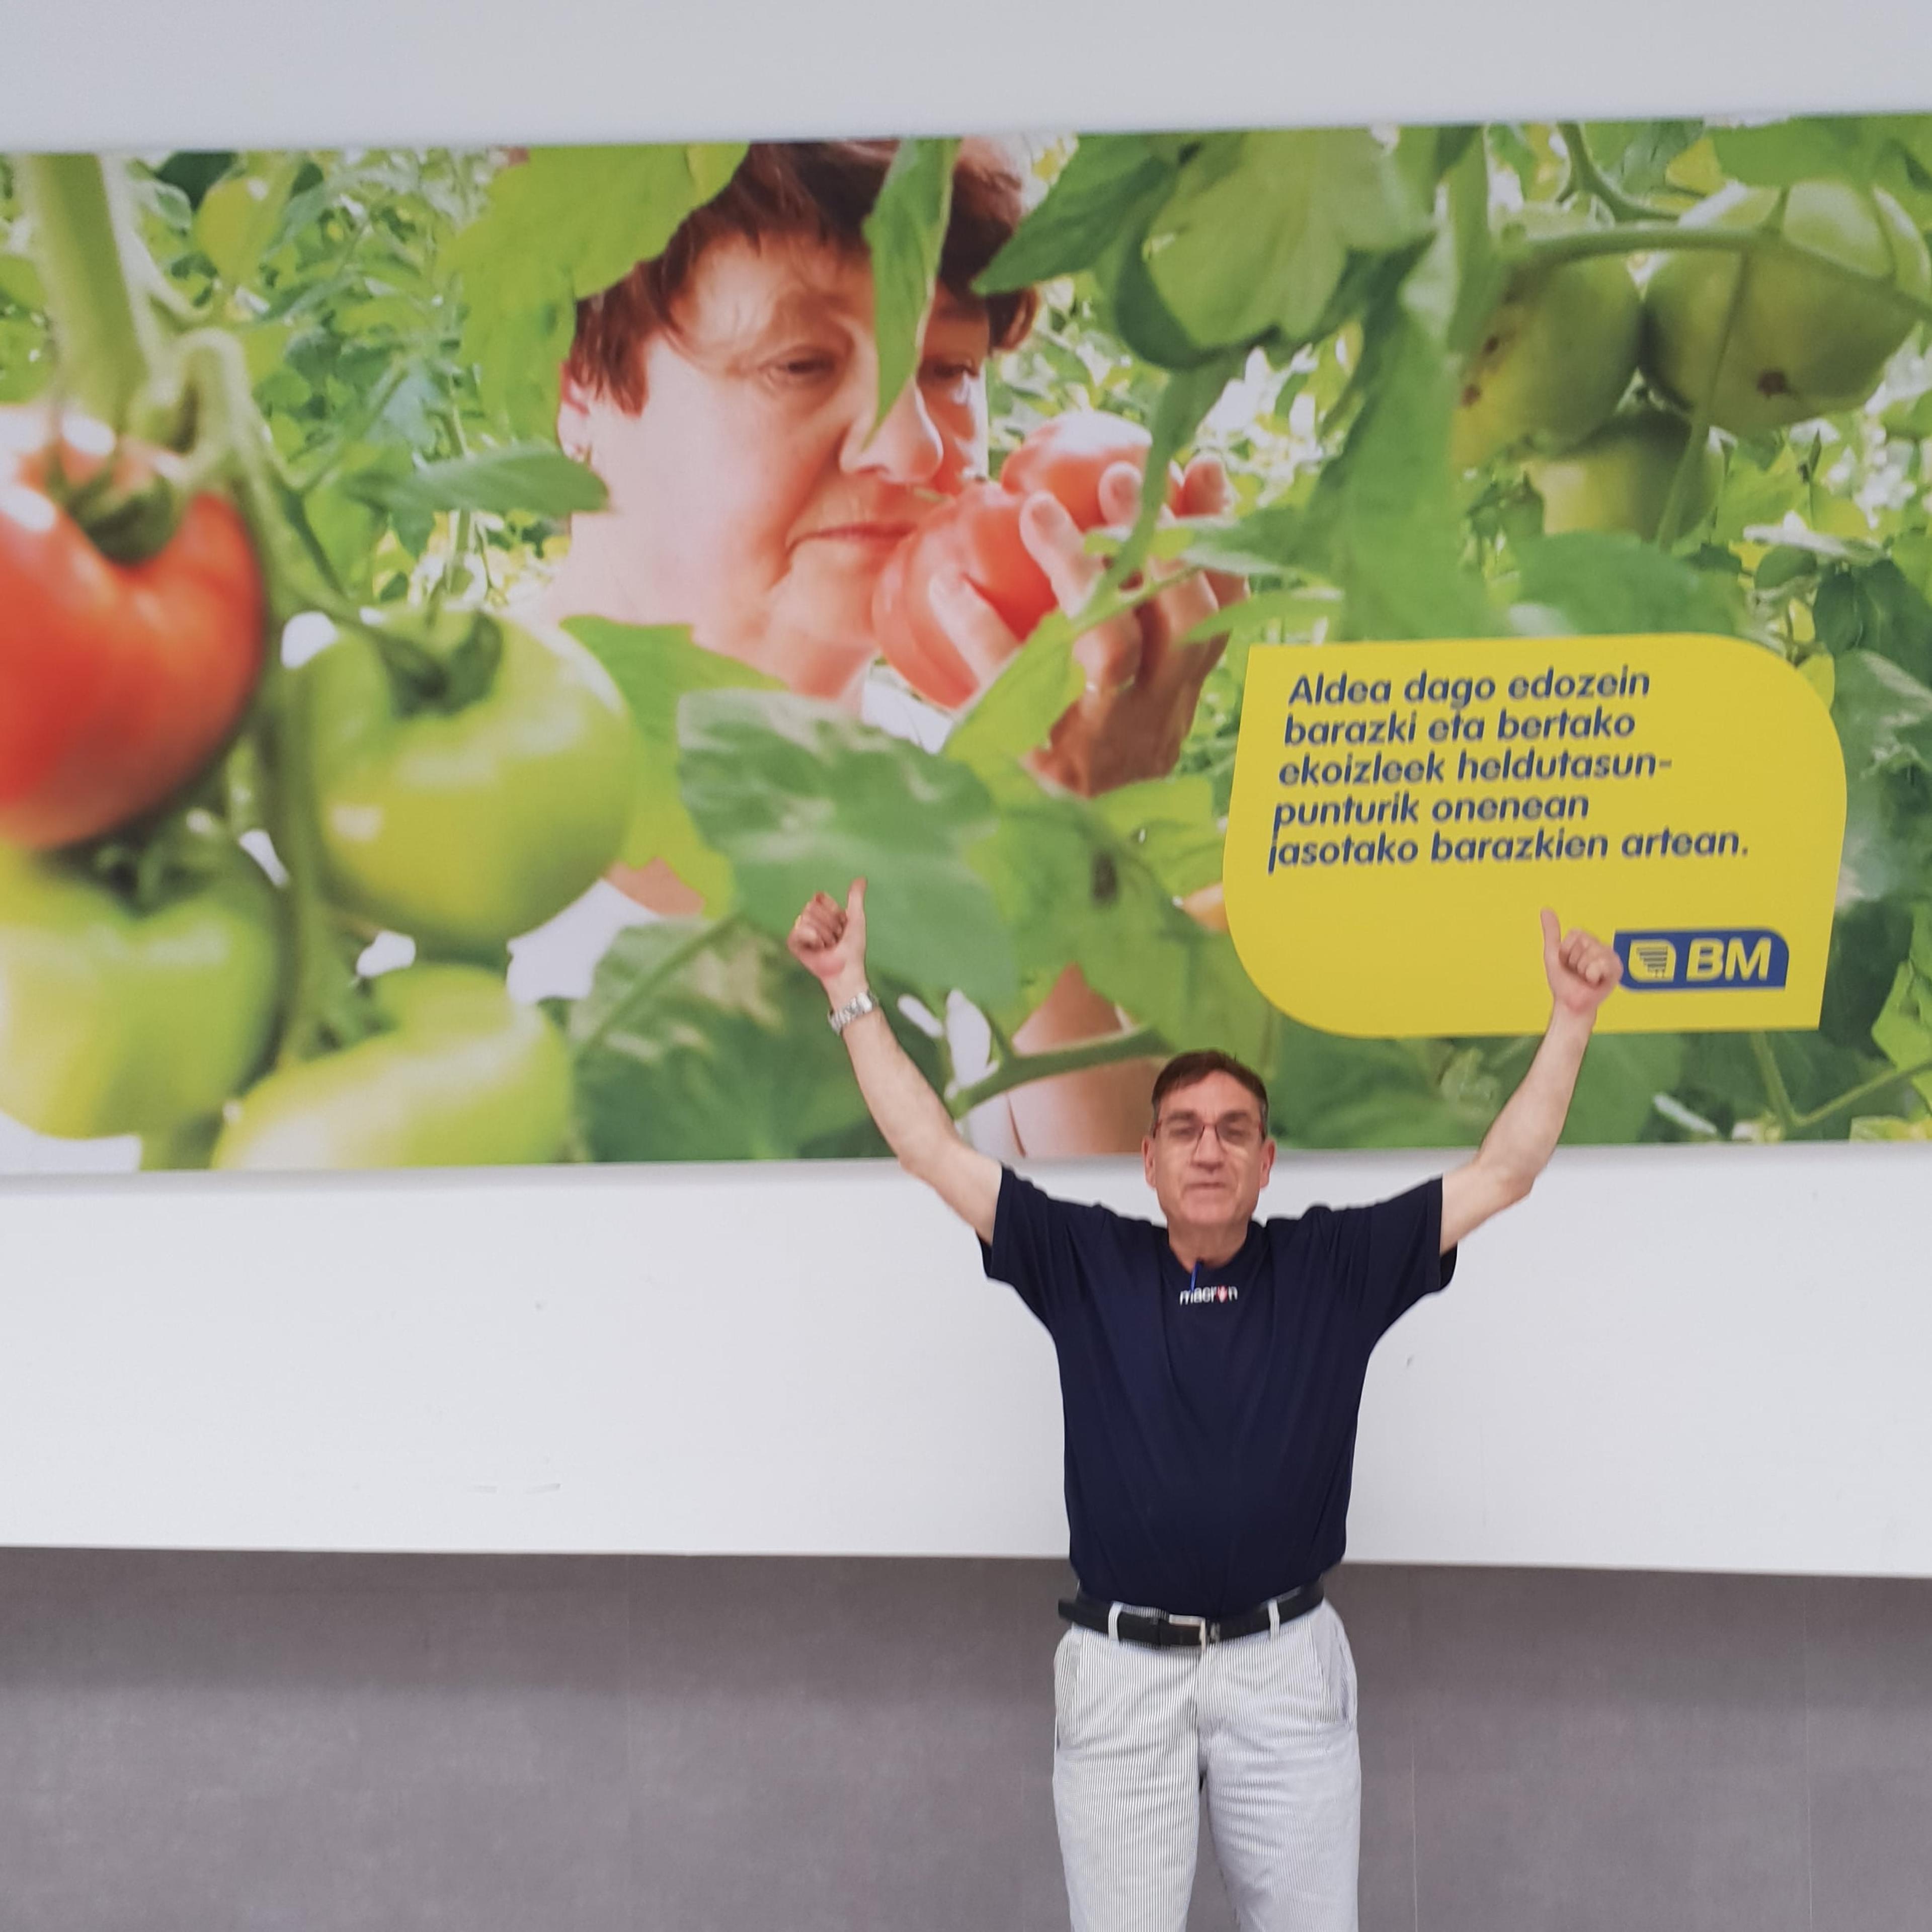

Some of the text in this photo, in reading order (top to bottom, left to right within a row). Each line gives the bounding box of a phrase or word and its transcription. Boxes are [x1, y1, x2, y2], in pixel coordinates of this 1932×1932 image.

[1287, 664, 1650, 710] Aldea dago edozein
[1283, 704, 1636, 747] barazki eta bertako
[1278, 747, 1673, 787] ekoizleek heldutasun-
[1273, 790, 1589, 838] punturik onenean
[1267, 826, 1749, 876] jasotako barazkien artean.
[1686, 938, 1772, 982] BM
